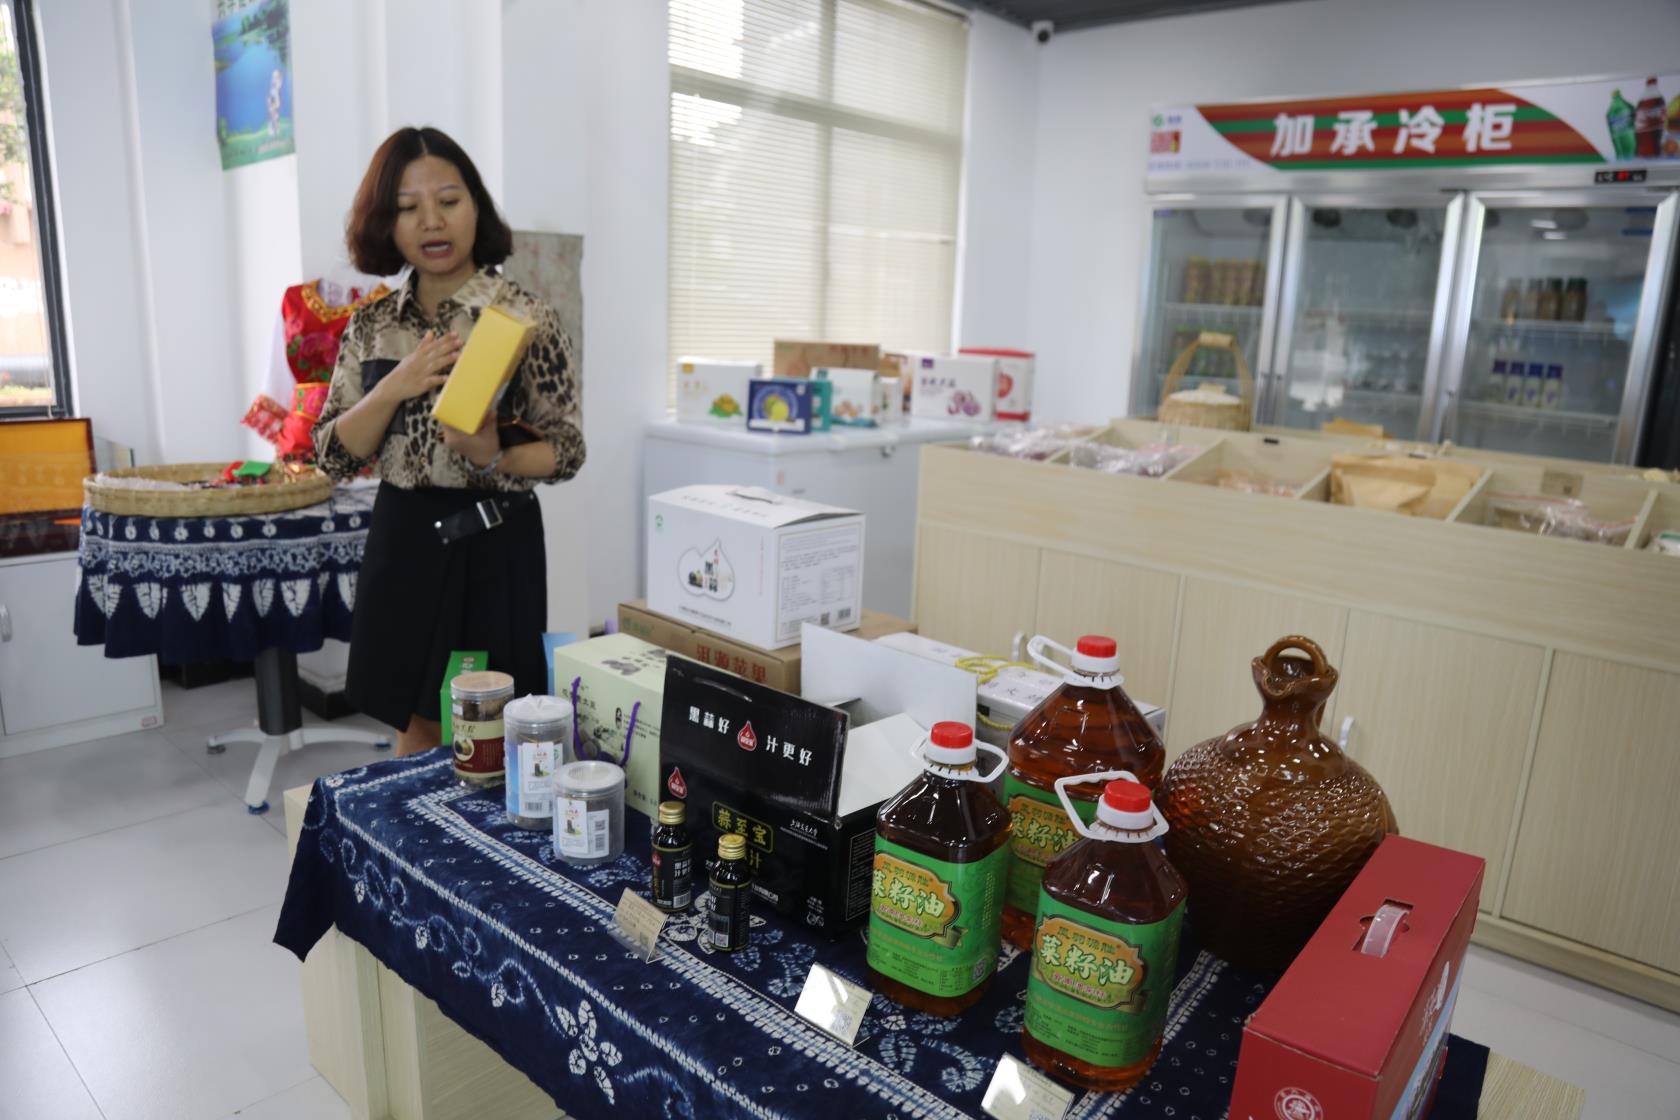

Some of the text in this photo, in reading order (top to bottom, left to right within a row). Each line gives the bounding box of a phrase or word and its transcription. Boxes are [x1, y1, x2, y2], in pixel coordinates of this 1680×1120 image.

[1270, 102, 1517, 158] 加承冷柜
[688, 705, 730, 735] 黑蒜好
[766, 735, 813, 767] 汁更好
[872, 869, 945, 918] 菜籽油
[1039, 934, 1135, 986] 菜籽油
